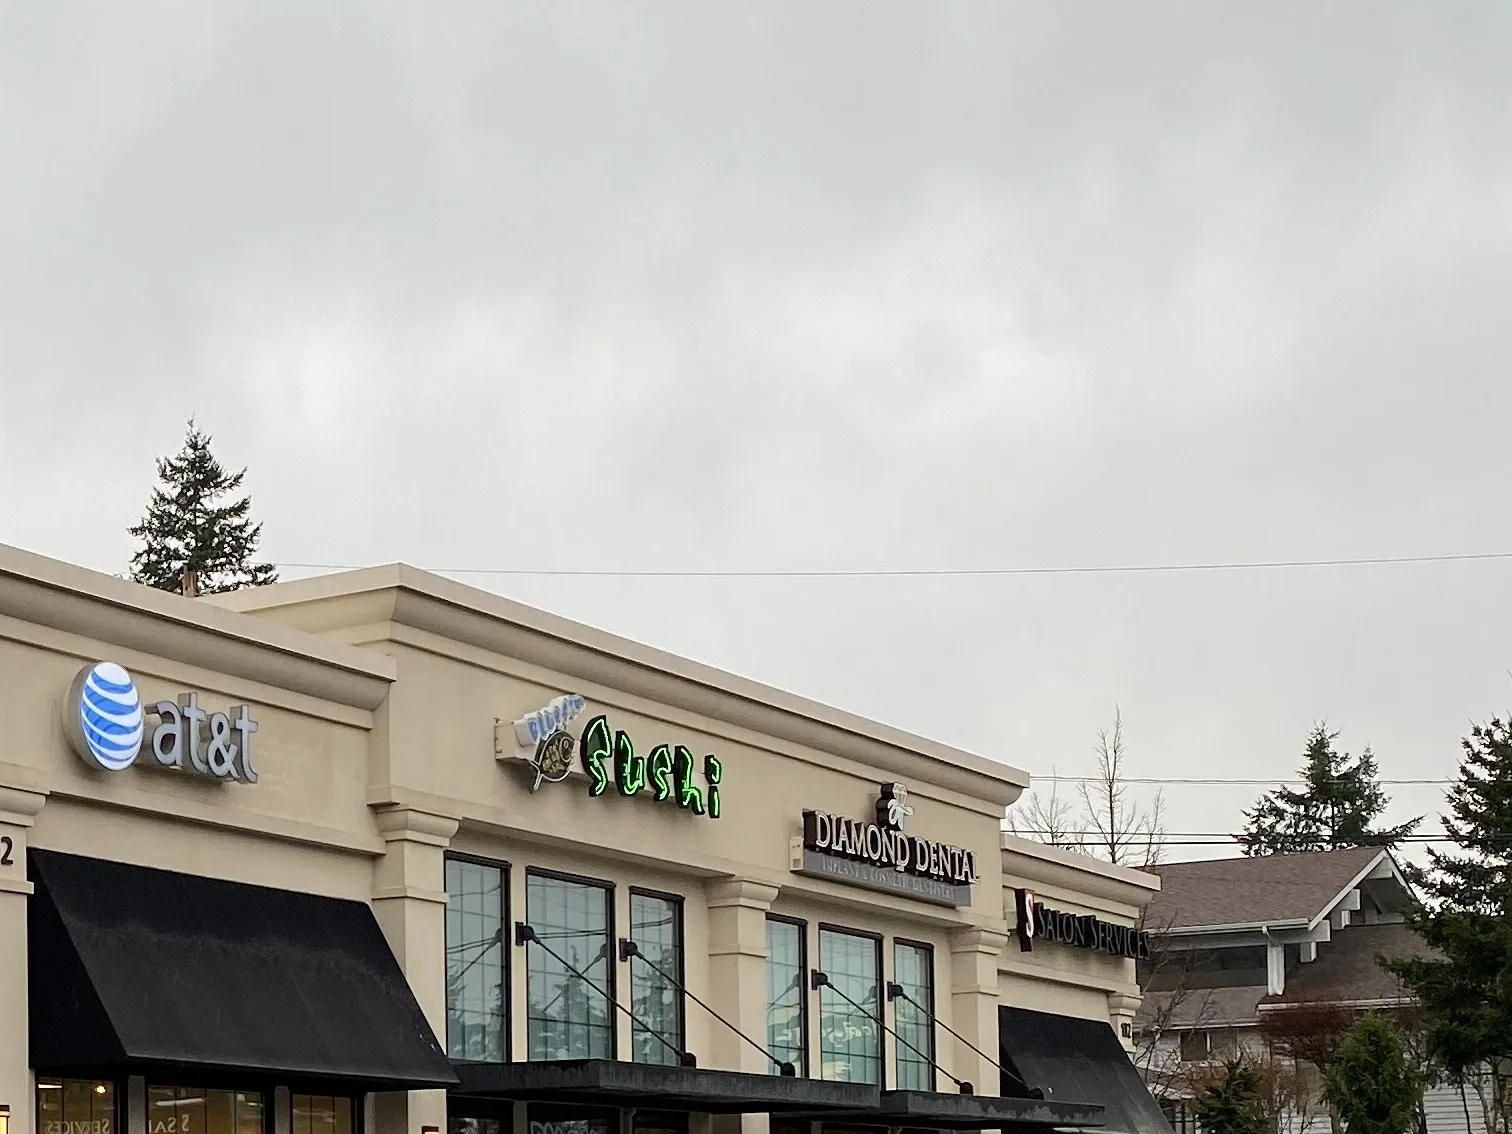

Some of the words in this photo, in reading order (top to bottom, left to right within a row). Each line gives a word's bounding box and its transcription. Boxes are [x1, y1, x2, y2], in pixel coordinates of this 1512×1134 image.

[148, 692, 258, 783] at&t
[814, 810, 910, 869] DIAMOND
[915, 837, 980, 884] DENTAL
[1038, 904, 1086, 947] SALON
[1091, 918, 1150, 960] SERVICES
